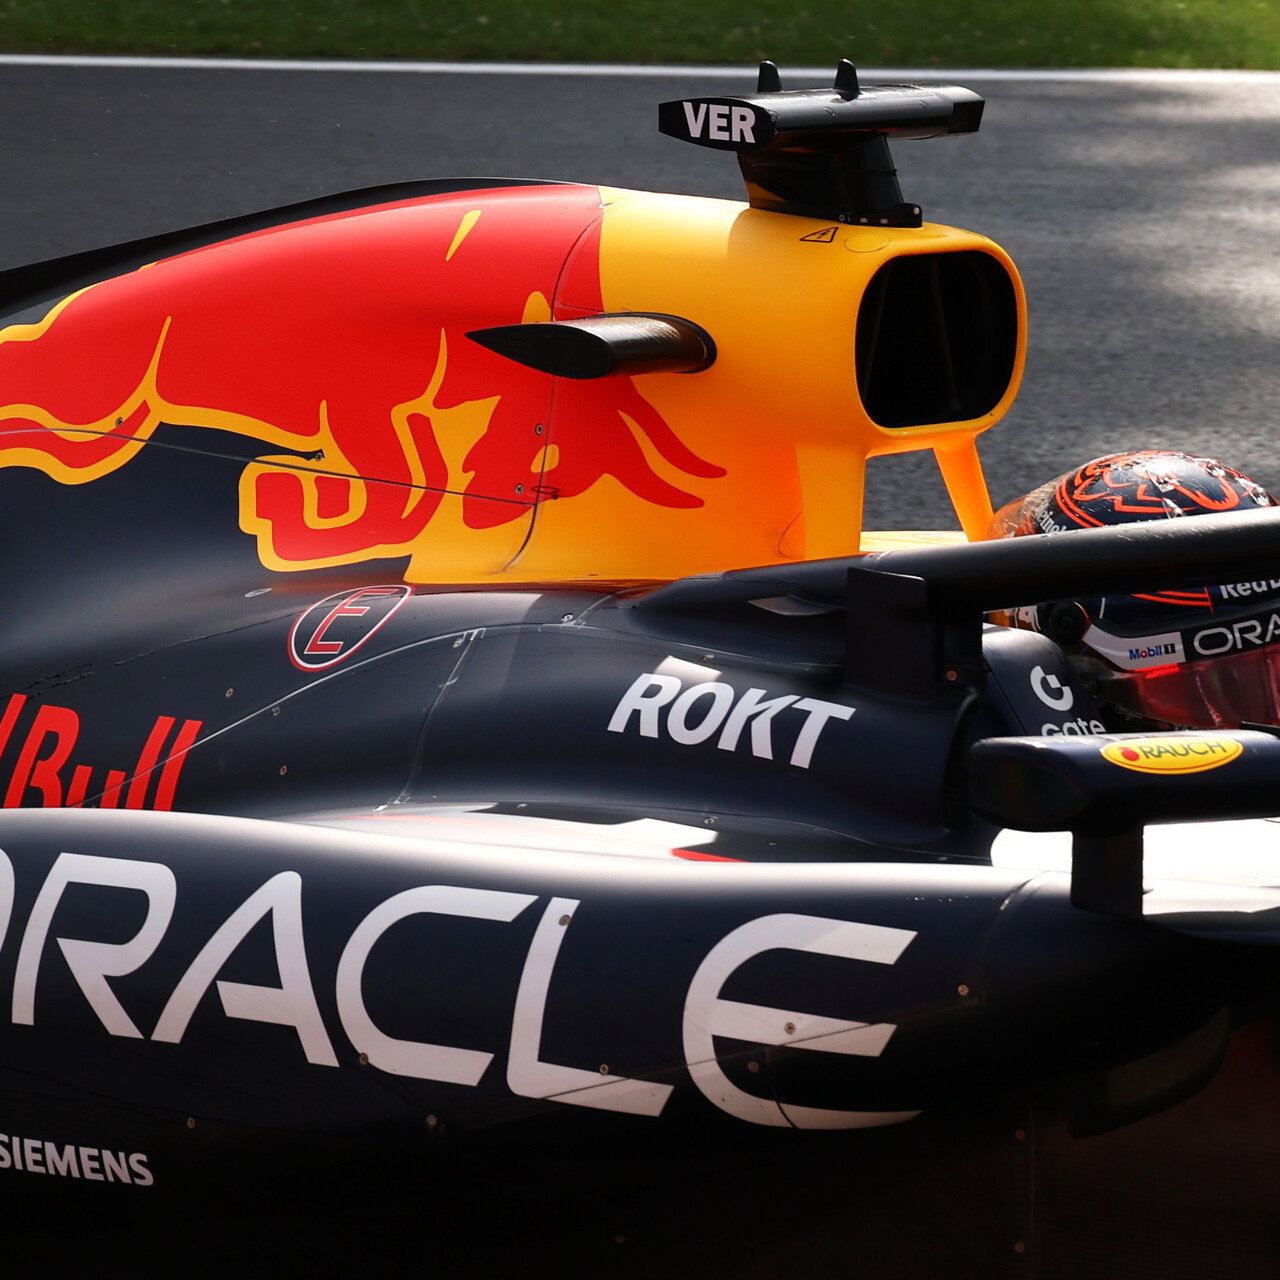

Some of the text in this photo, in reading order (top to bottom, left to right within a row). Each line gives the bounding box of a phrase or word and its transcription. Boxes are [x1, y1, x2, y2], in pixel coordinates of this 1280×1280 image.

[682, 101, 756, 144] VER
[304, 589, 399, 654] E
[1129, 645, 1162, 660] Mobil
[607, 673, 856, 769] ROKT
[1138, 741, 1226, 759] RAUCH
[0, 848, 921, 1129] RACLE
